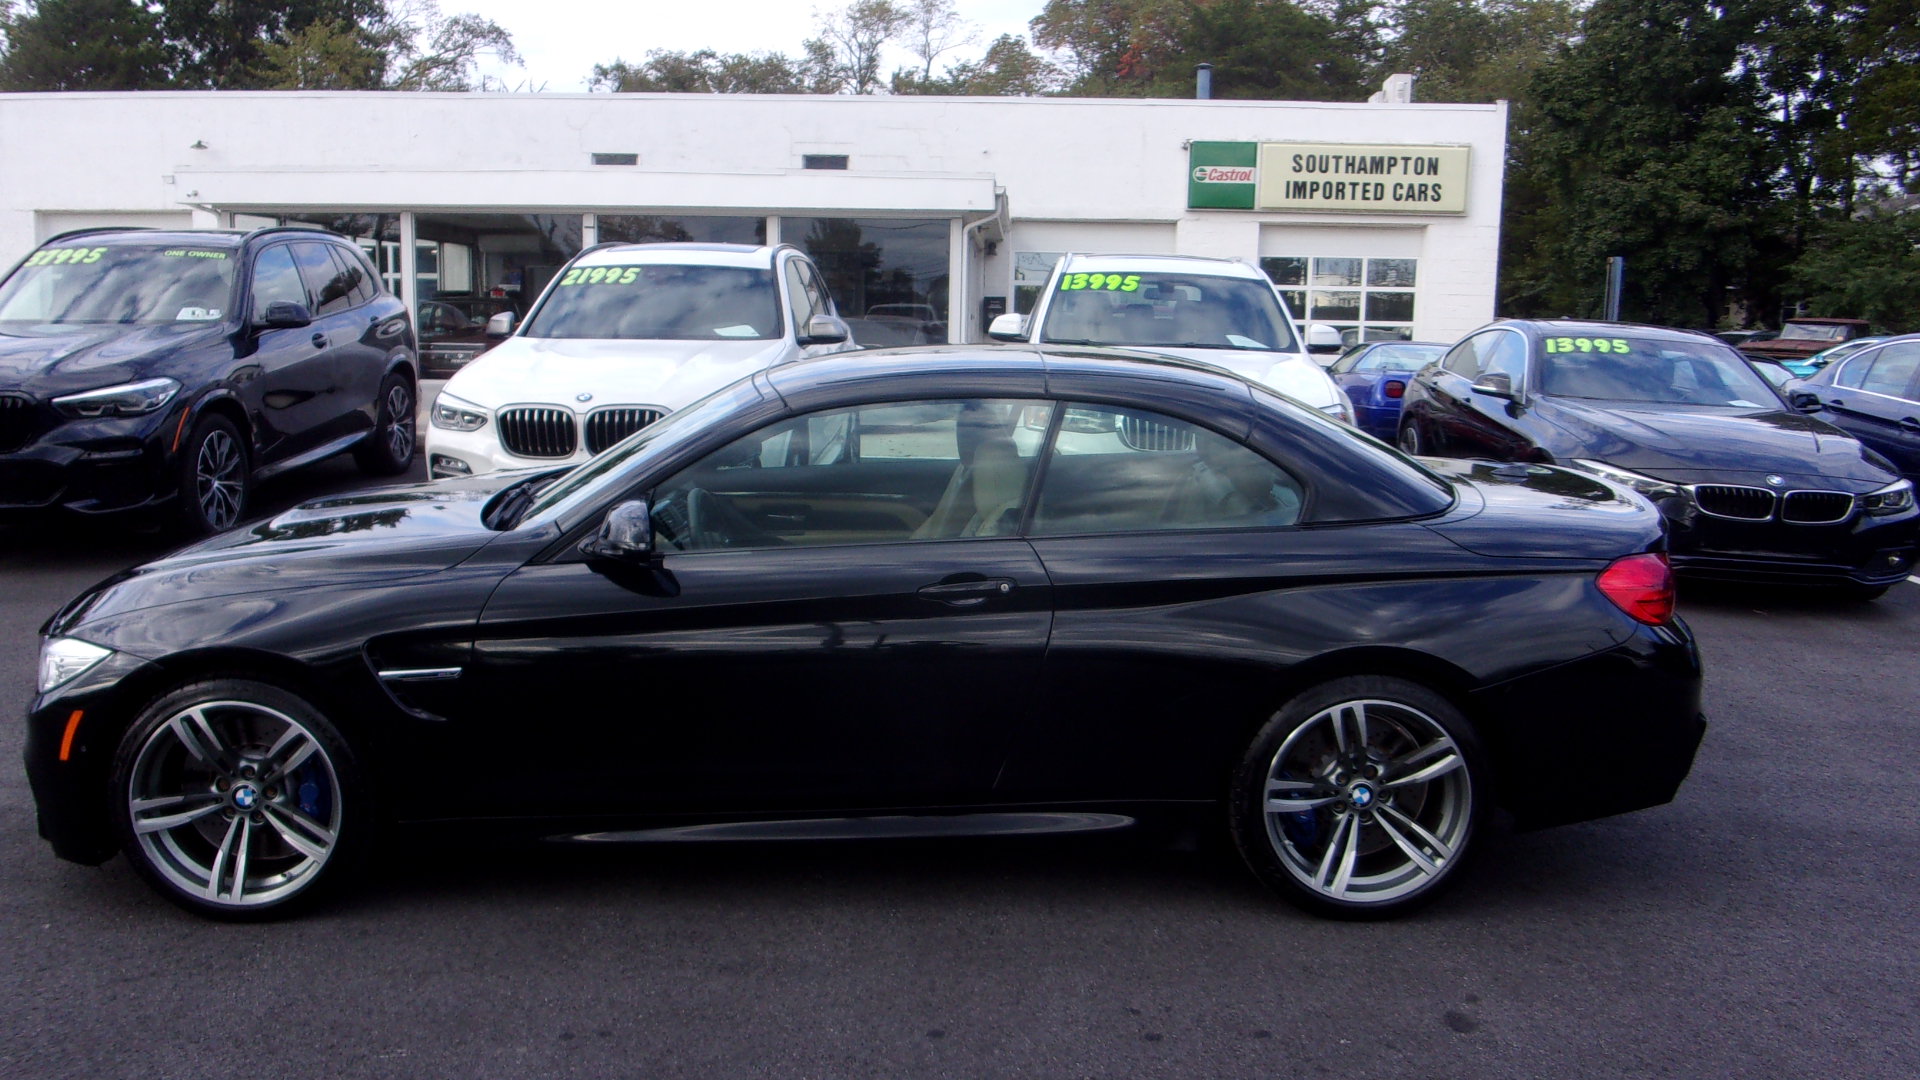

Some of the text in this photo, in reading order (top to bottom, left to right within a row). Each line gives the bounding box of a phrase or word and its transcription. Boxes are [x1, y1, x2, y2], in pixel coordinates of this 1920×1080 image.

[1208, 168, 1252, 181] Castrol
[1292, 154, 1439, 176] SOUTHAMPTON
[1285, 180, 1442, 202] IMPORTED CARS
[188, 250, 226, 259] OWNER
[560, 267, 641, 286] 21995
[1060, 273, 1142, 292] 13995
[1546, 337, 1631, 354] 13995
